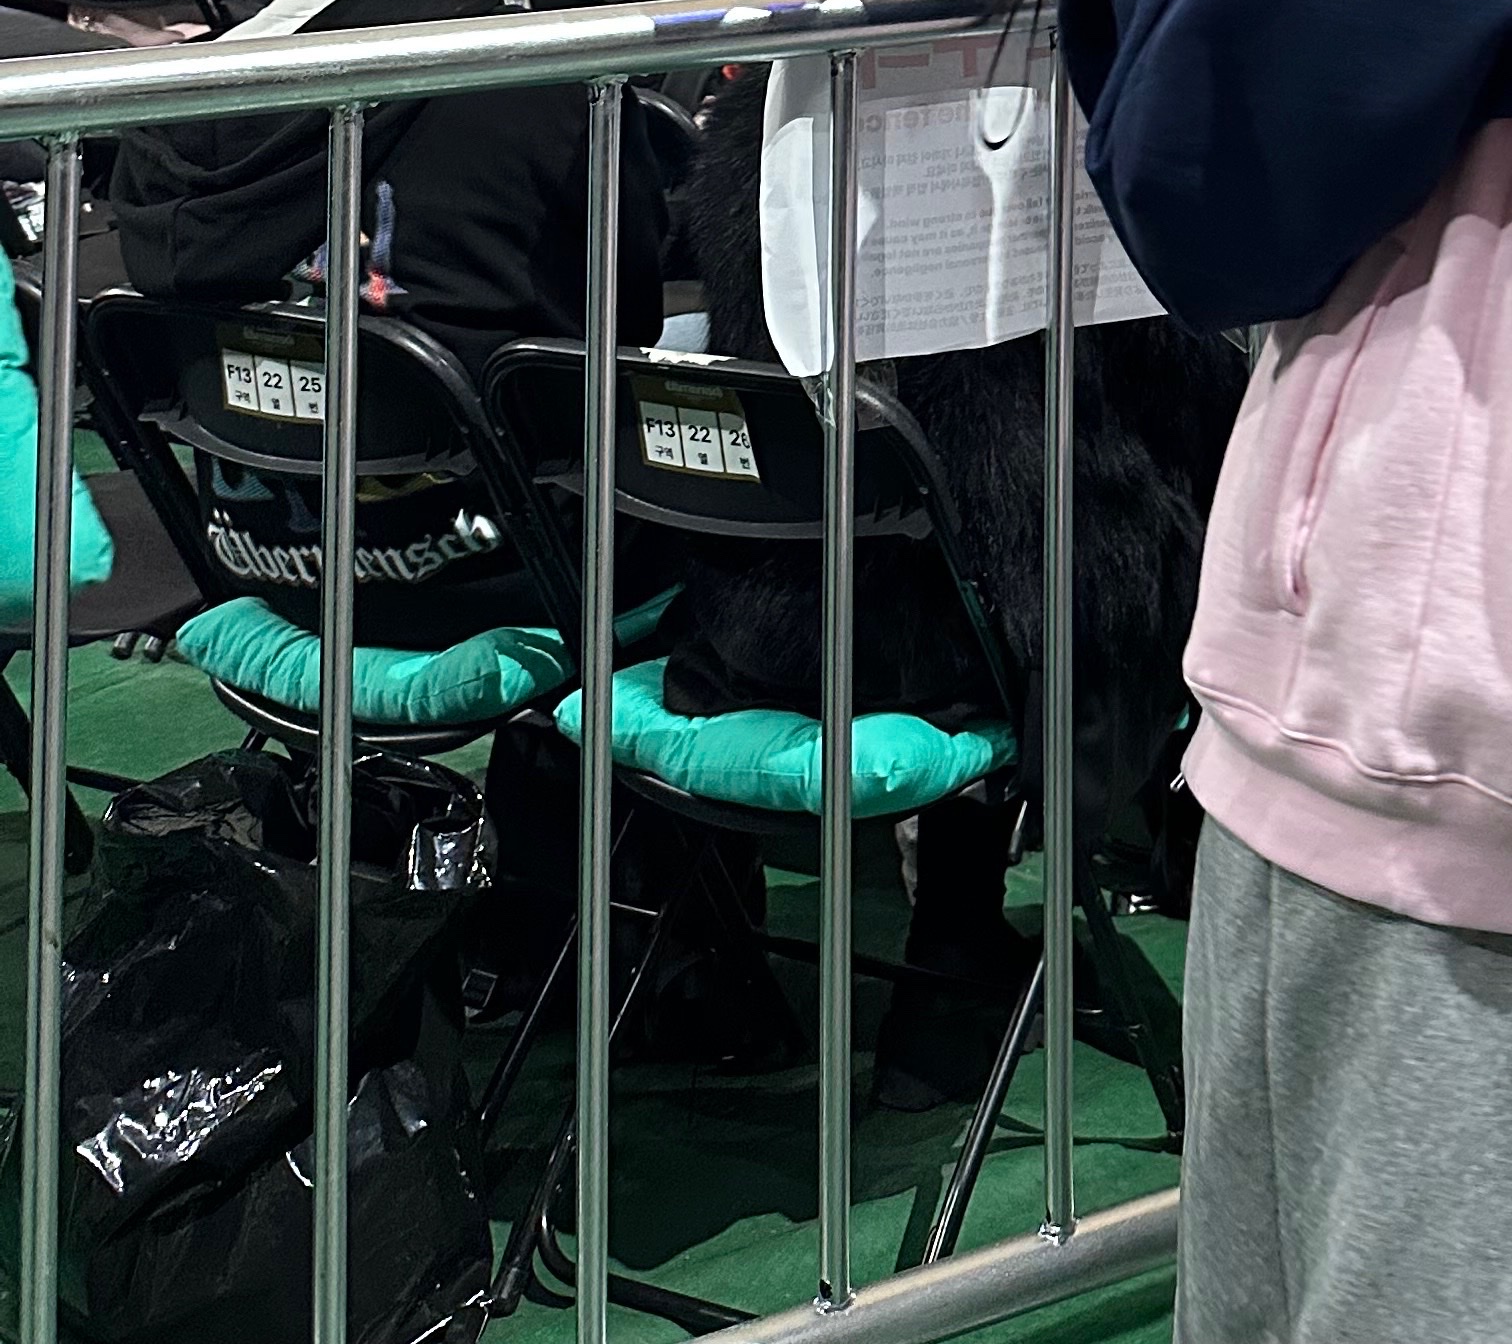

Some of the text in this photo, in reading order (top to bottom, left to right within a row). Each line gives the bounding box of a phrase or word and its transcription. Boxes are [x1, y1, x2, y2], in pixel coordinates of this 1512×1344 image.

[227, 364, 322, 393] F13 22 25
[645, 417, 676, 438] F13
[688, 424, 712, 444] 22
[207, 508, 500, 587] Überensch
